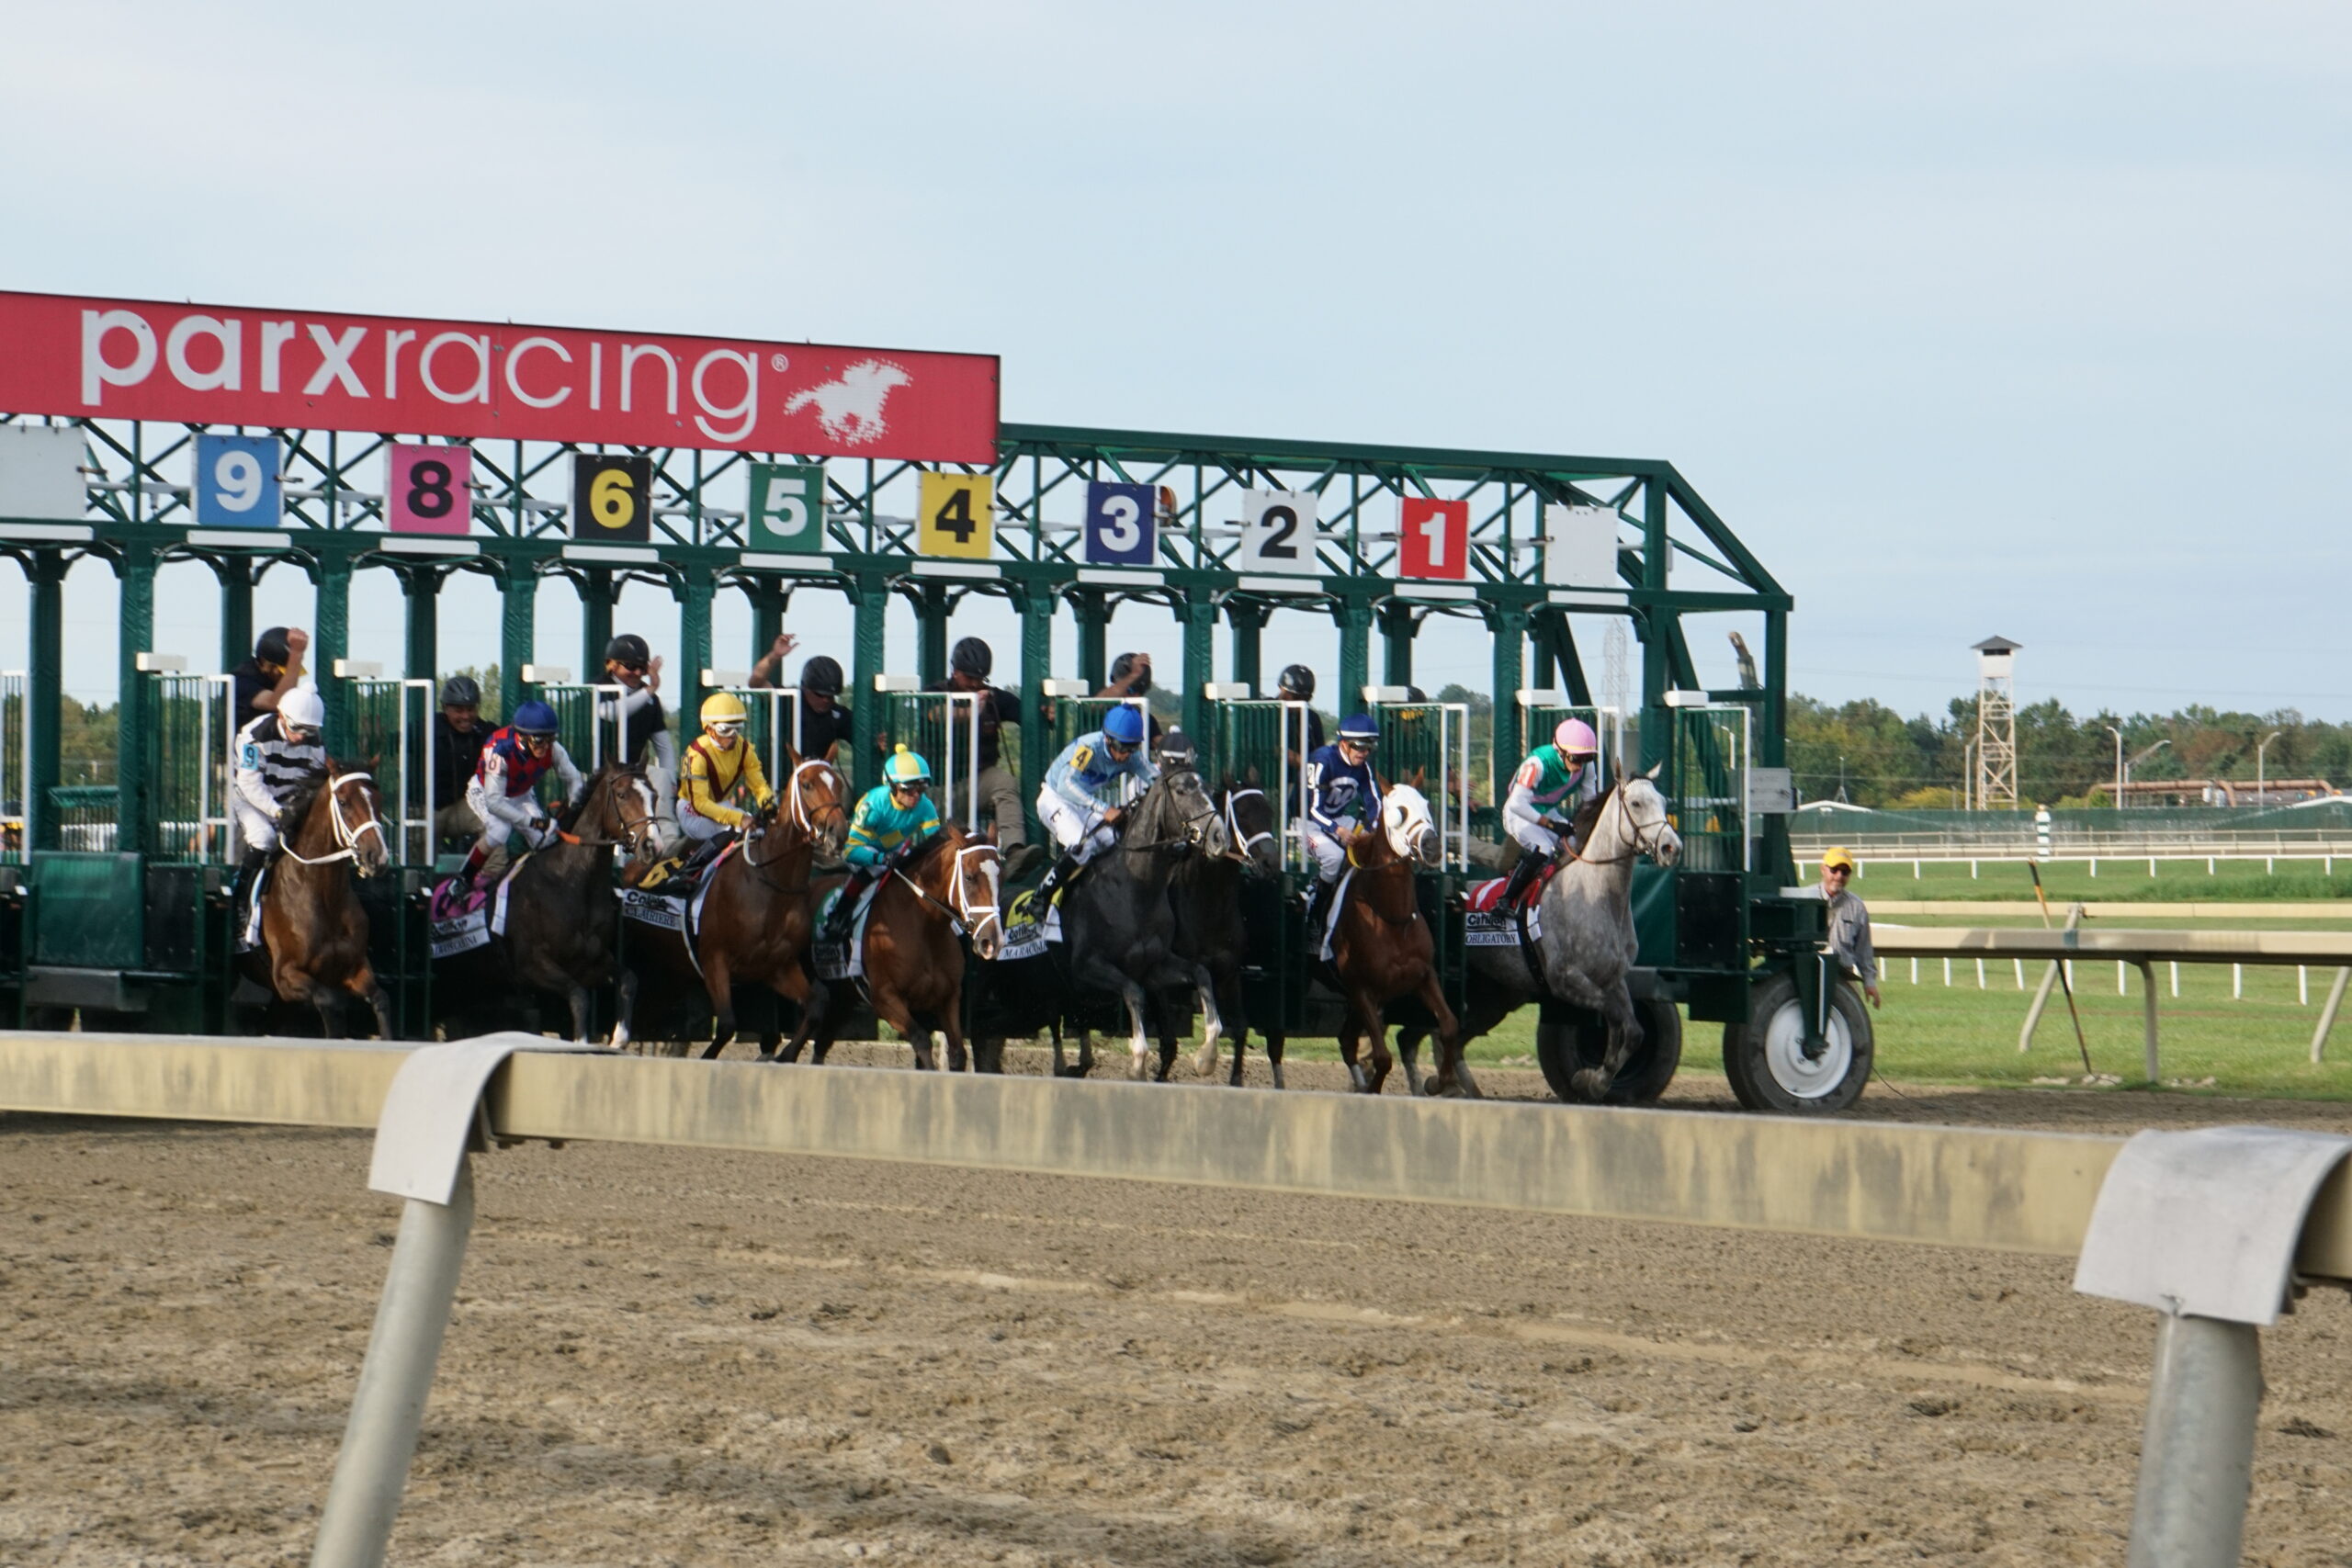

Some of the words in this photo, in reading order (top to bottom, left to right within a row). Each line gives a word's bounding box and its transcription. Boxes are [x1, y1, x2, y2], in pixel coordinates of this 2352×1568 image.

[214, 450, 263, 513] 9
[407, 460, 453, 519] 8
[590, 468, 634, 529] 6
[763, 478, 808, 536] 5
[934, 488, 976, 544] 4
[1099, 495, 1140, 552] 3
[1259, 505, 1297, 559] 2
[1419, 512, 1446, 567] 1
[246, 746, 255, 768] 9
[1076, 750, 1088, 768] 4
[1465, 933, 1517, 944] OBLIGATORY
